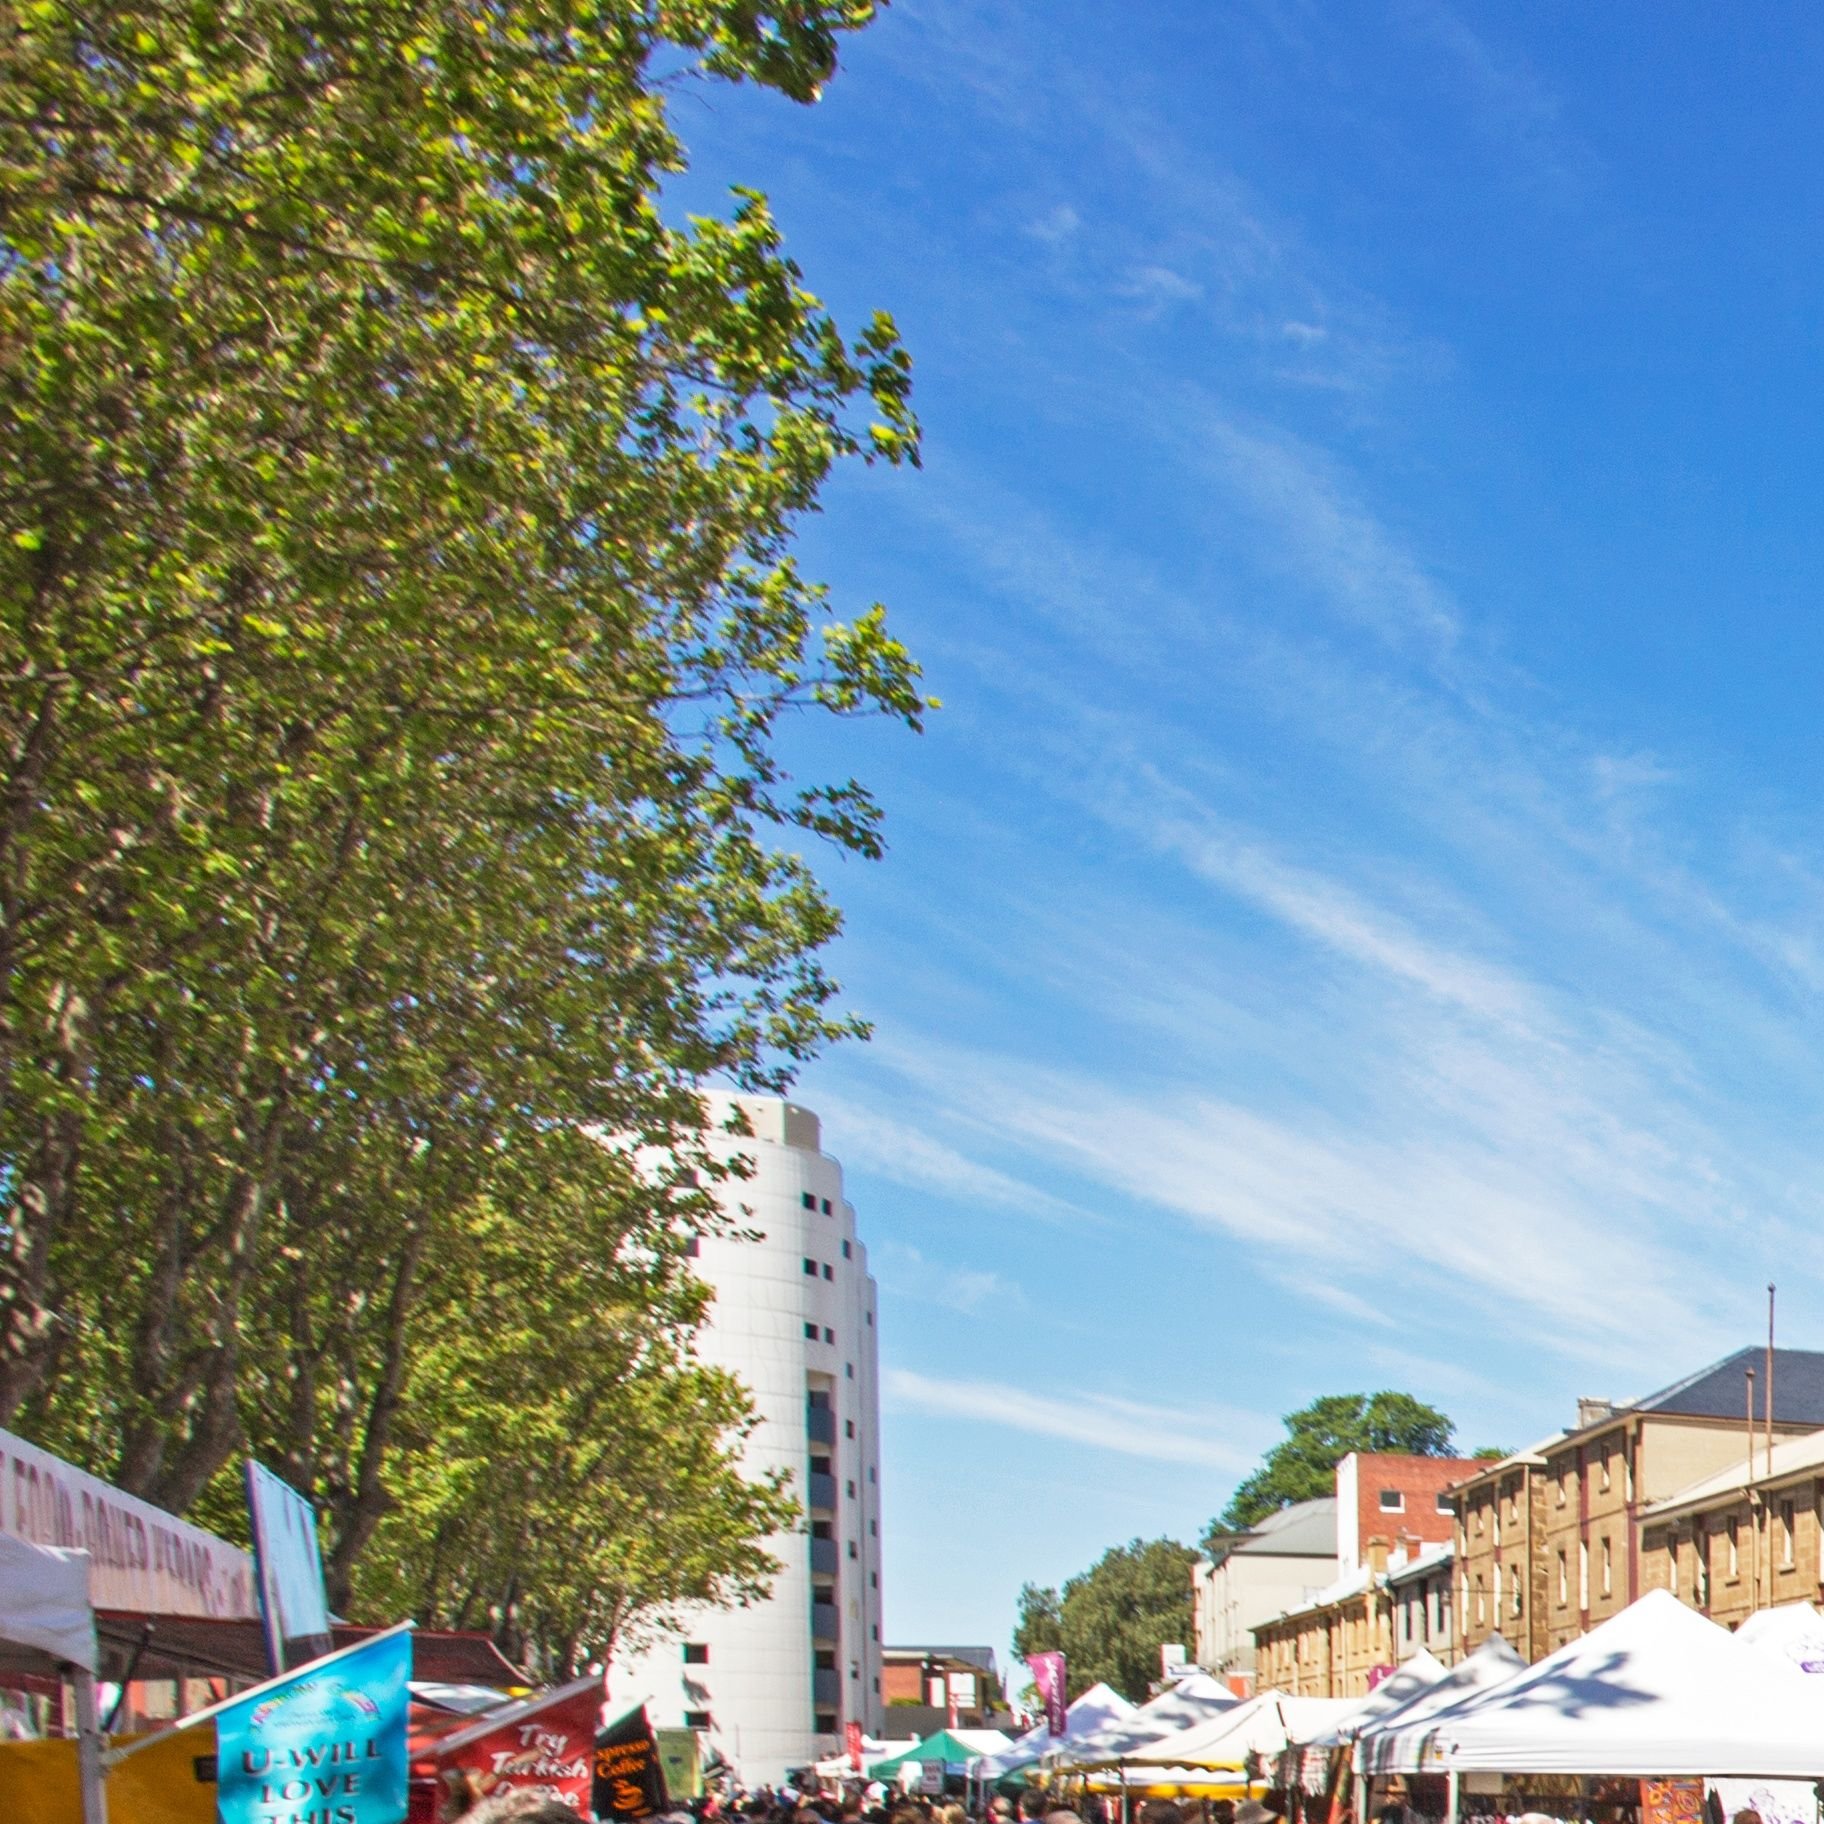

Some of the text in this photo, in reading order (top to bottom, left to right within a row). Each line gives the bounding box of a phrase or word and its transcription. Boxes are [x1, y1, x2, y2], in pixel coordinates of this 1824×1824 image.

[242, 1738, 383, 1776] U-WILL
[518, 1723, 569, 1757] Try
[261, 1773, 361, 1805] LOVE
